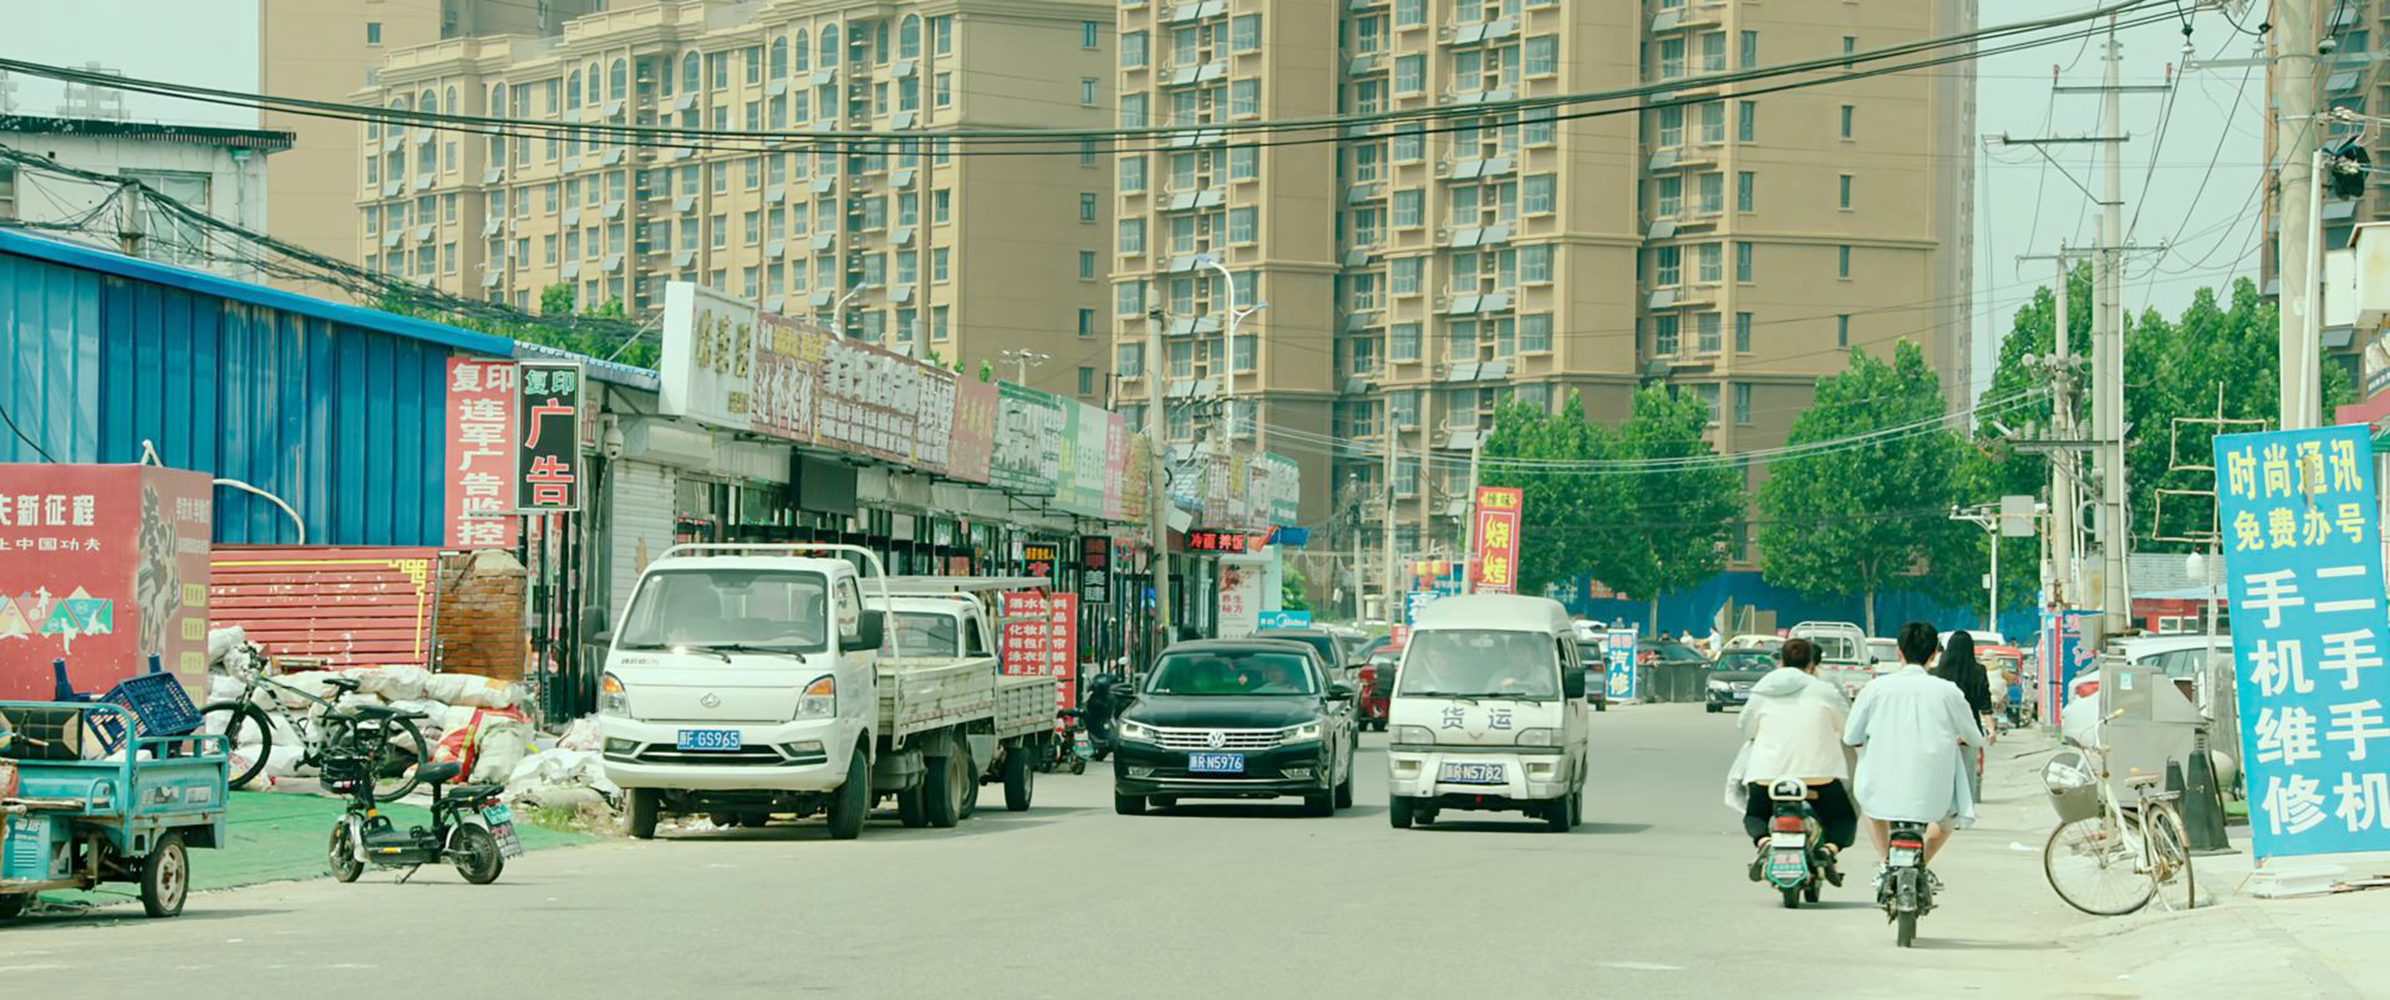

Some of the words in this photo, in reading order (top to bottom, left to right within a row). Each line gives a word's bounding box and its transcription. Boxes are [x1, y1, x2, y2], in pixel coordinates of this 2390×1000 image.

[452, 363, 514, 393] 复印
[525, 370, 575, 396] 复印
[525, 398, 575, 505] 广告
[2227, 438, 2363, 501] 时尚通讯
[1482, 513, 1510, 584] 烧烤
[2233, 502, 2366, 552] 免费办号
[1009, 625, 1067, 636] 化妆用品
[1609, 649, 1631, 696] 汽修
[1441, 706, 1513, 730] 货运
[2241, 568, 2328, 836] 手机维修
[2313, 565, 2390, 833] 二手手机
